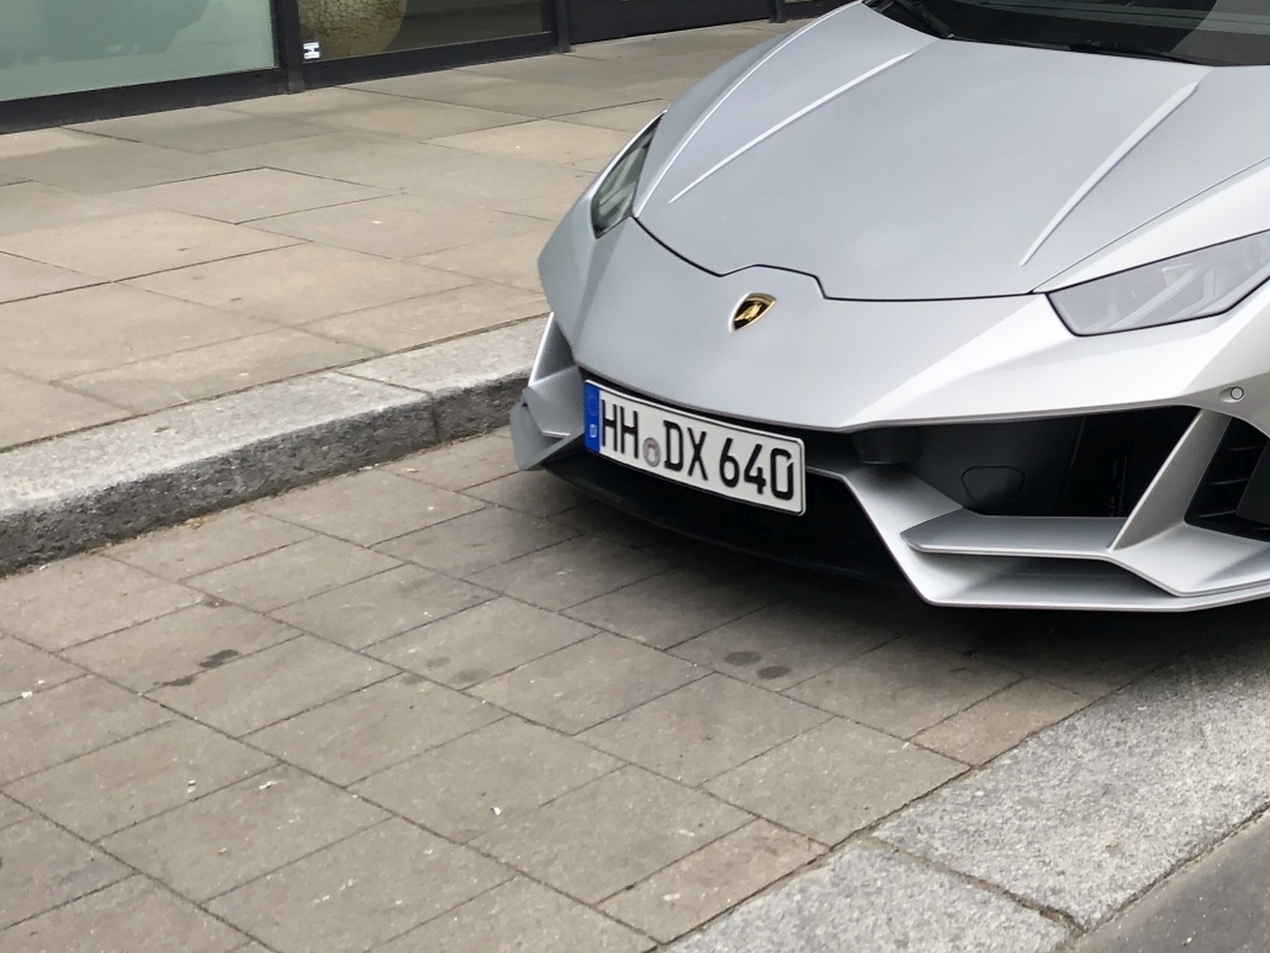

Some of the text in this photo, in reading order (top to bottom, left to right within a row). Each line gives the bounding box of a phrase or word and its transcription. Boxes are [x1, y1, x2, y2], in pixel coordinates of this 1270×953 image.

[601, 399, 794, 501] HH DX 640
